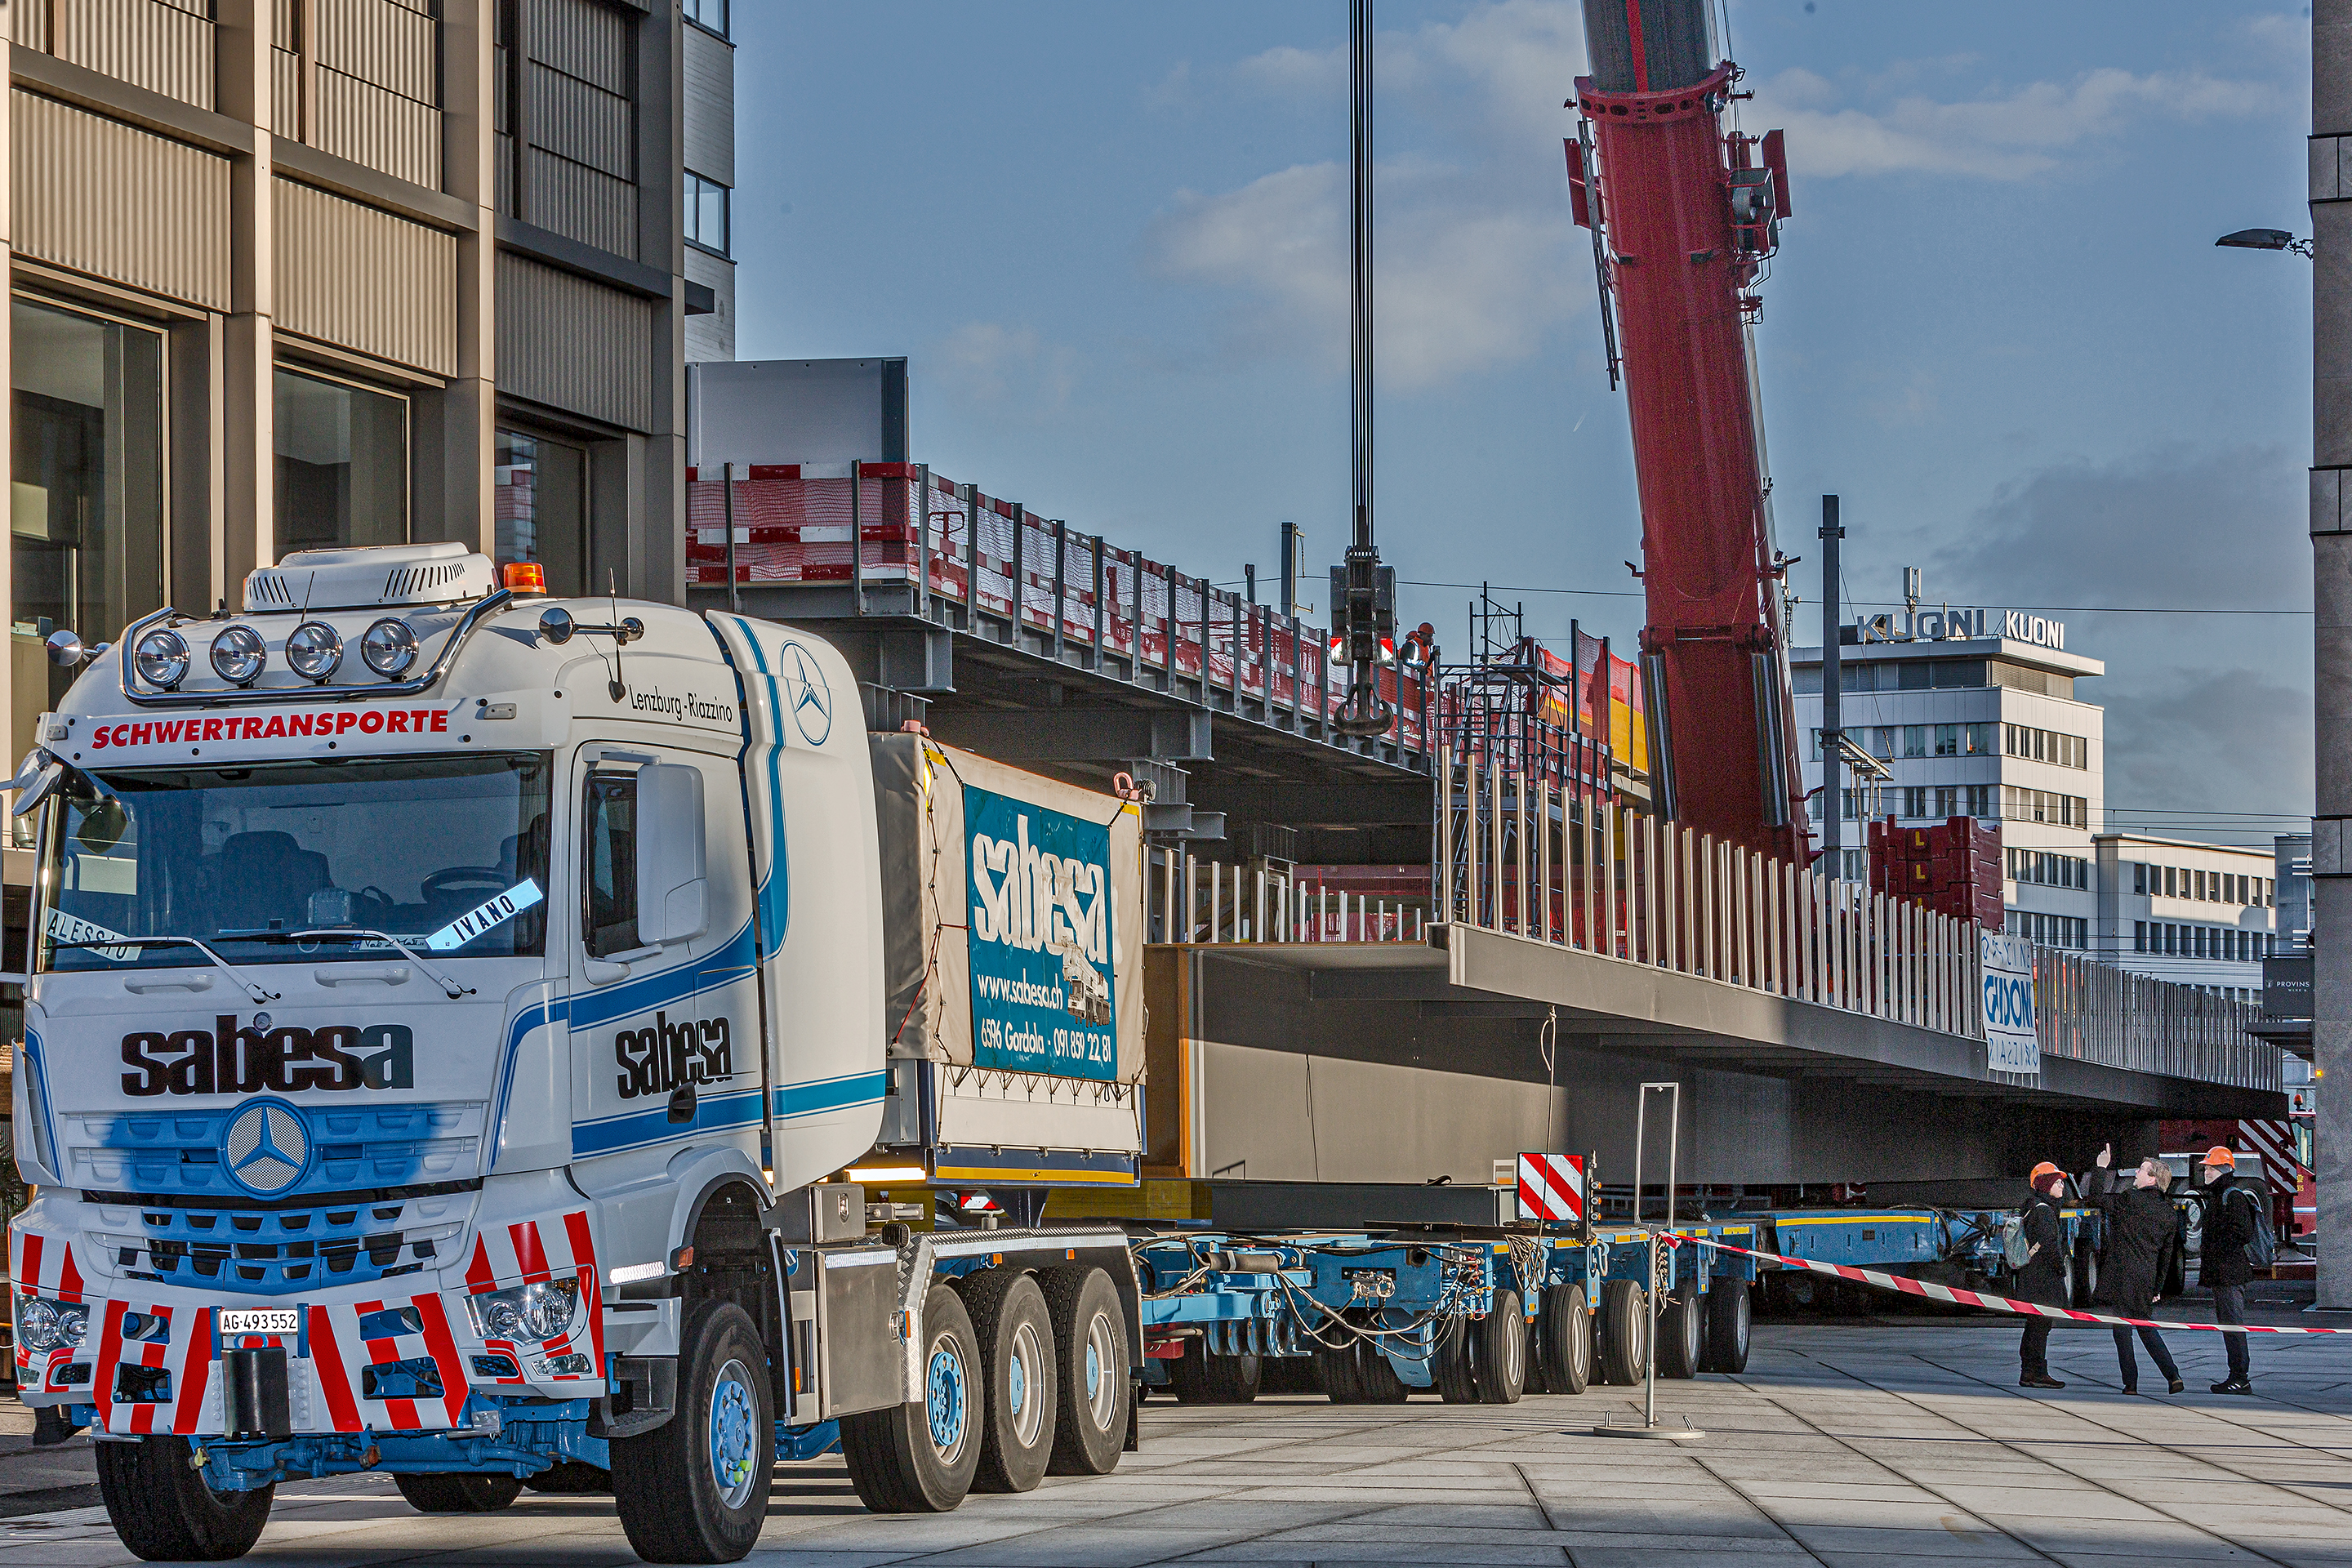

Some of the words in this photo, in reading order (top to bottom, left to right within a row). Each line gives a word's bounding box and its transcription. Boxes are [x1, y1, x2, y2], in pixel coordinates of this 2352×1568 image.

[1857, 609, 1986, 645] KUONI
[2004, 610, 2065, 650] KUONI
[628, 684, 683, 722] Lenzburg
[91, 710, 449, 750] SCHWERTRANSPORTE
[973, 813, 1108, 964] sabesa
[452, 895, 515, 942] IVANO
[977, 967, 1064, 1010] www.sabesa.ch
[121, 1014, 414, 1096] sabesa
[615, 1010, 733, 1099] sabesa
[982, 1018, 1003, 1050] 6596
[1004, 1021, 1045, 1054] Gordola
[1054, 1027, 1070, 1058] 091
[1071, 1028, 1085, 1060] 859
[1087, 1032, 1101, 1061] 22
[1102, 1035, 1111, 1062] 81
